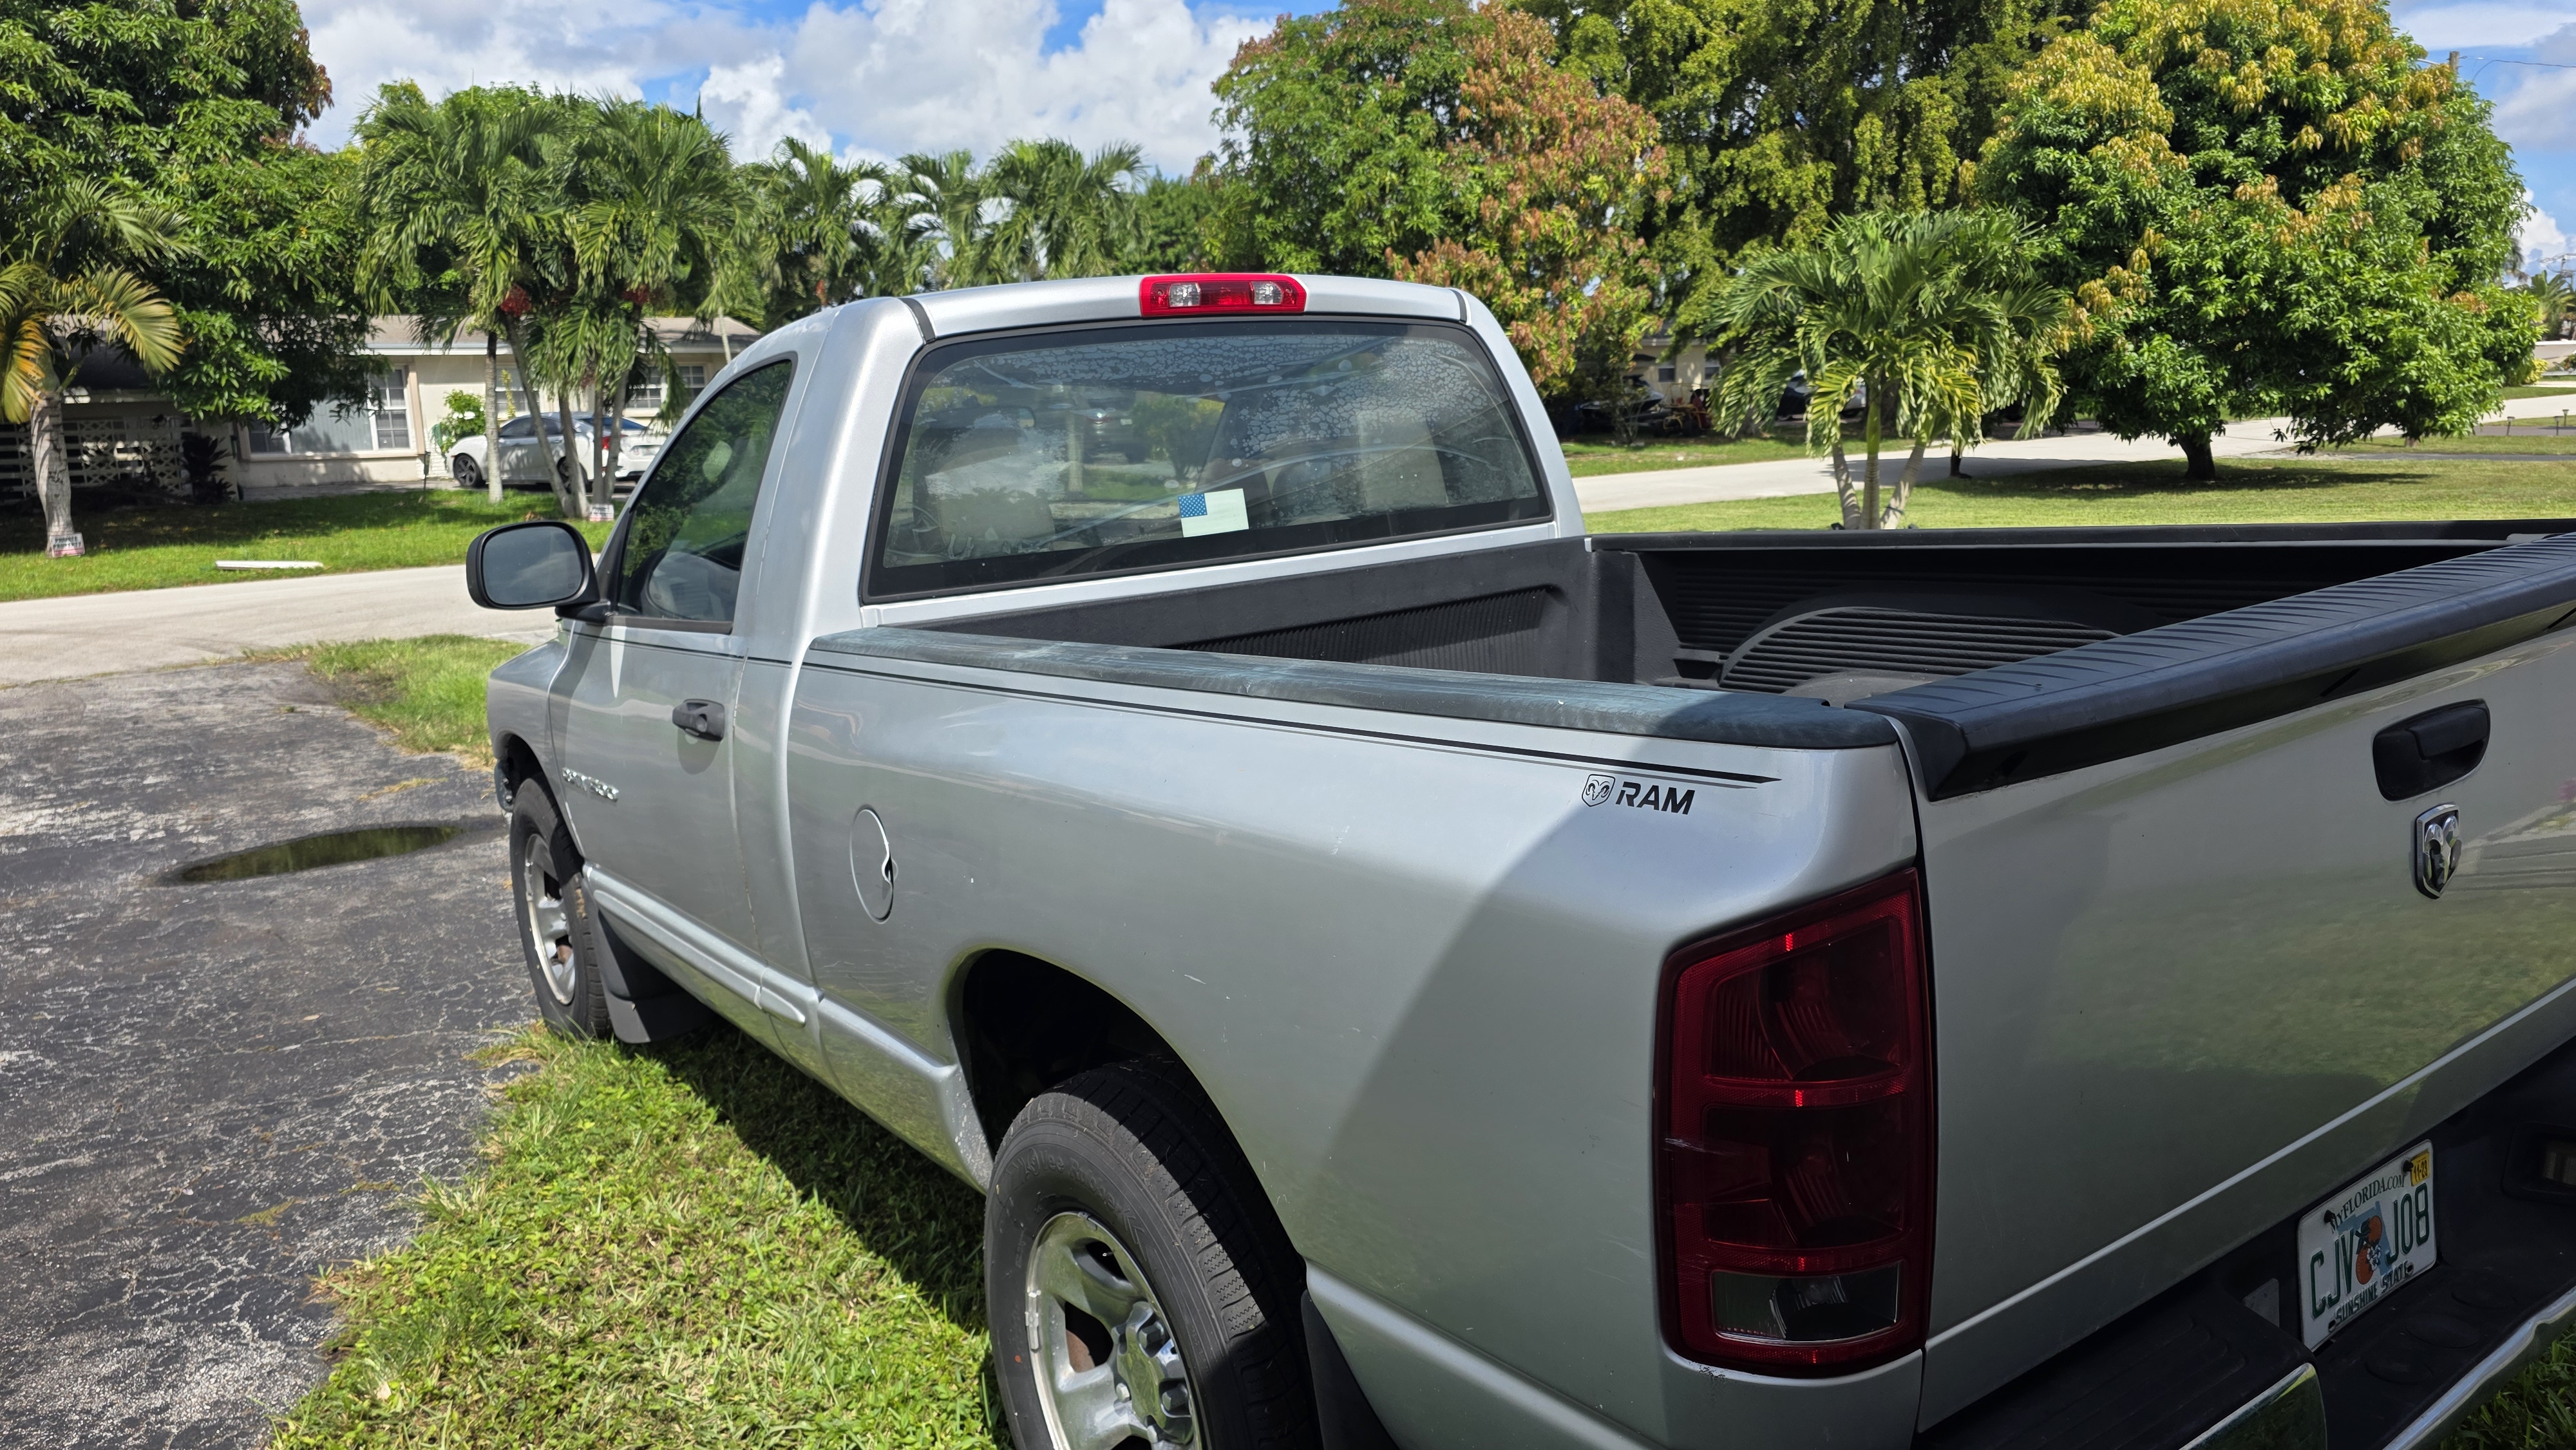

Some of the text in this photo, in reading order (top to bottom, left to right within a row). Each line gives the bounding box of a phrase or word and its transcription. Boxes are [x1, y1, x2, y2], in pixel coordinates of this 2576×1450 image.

[1616, 781, 1695, 815] RAM
[2310, 1228, 2354, 1319] CJV
[2335, 1281, 2378, 1325] SUNSHINE
